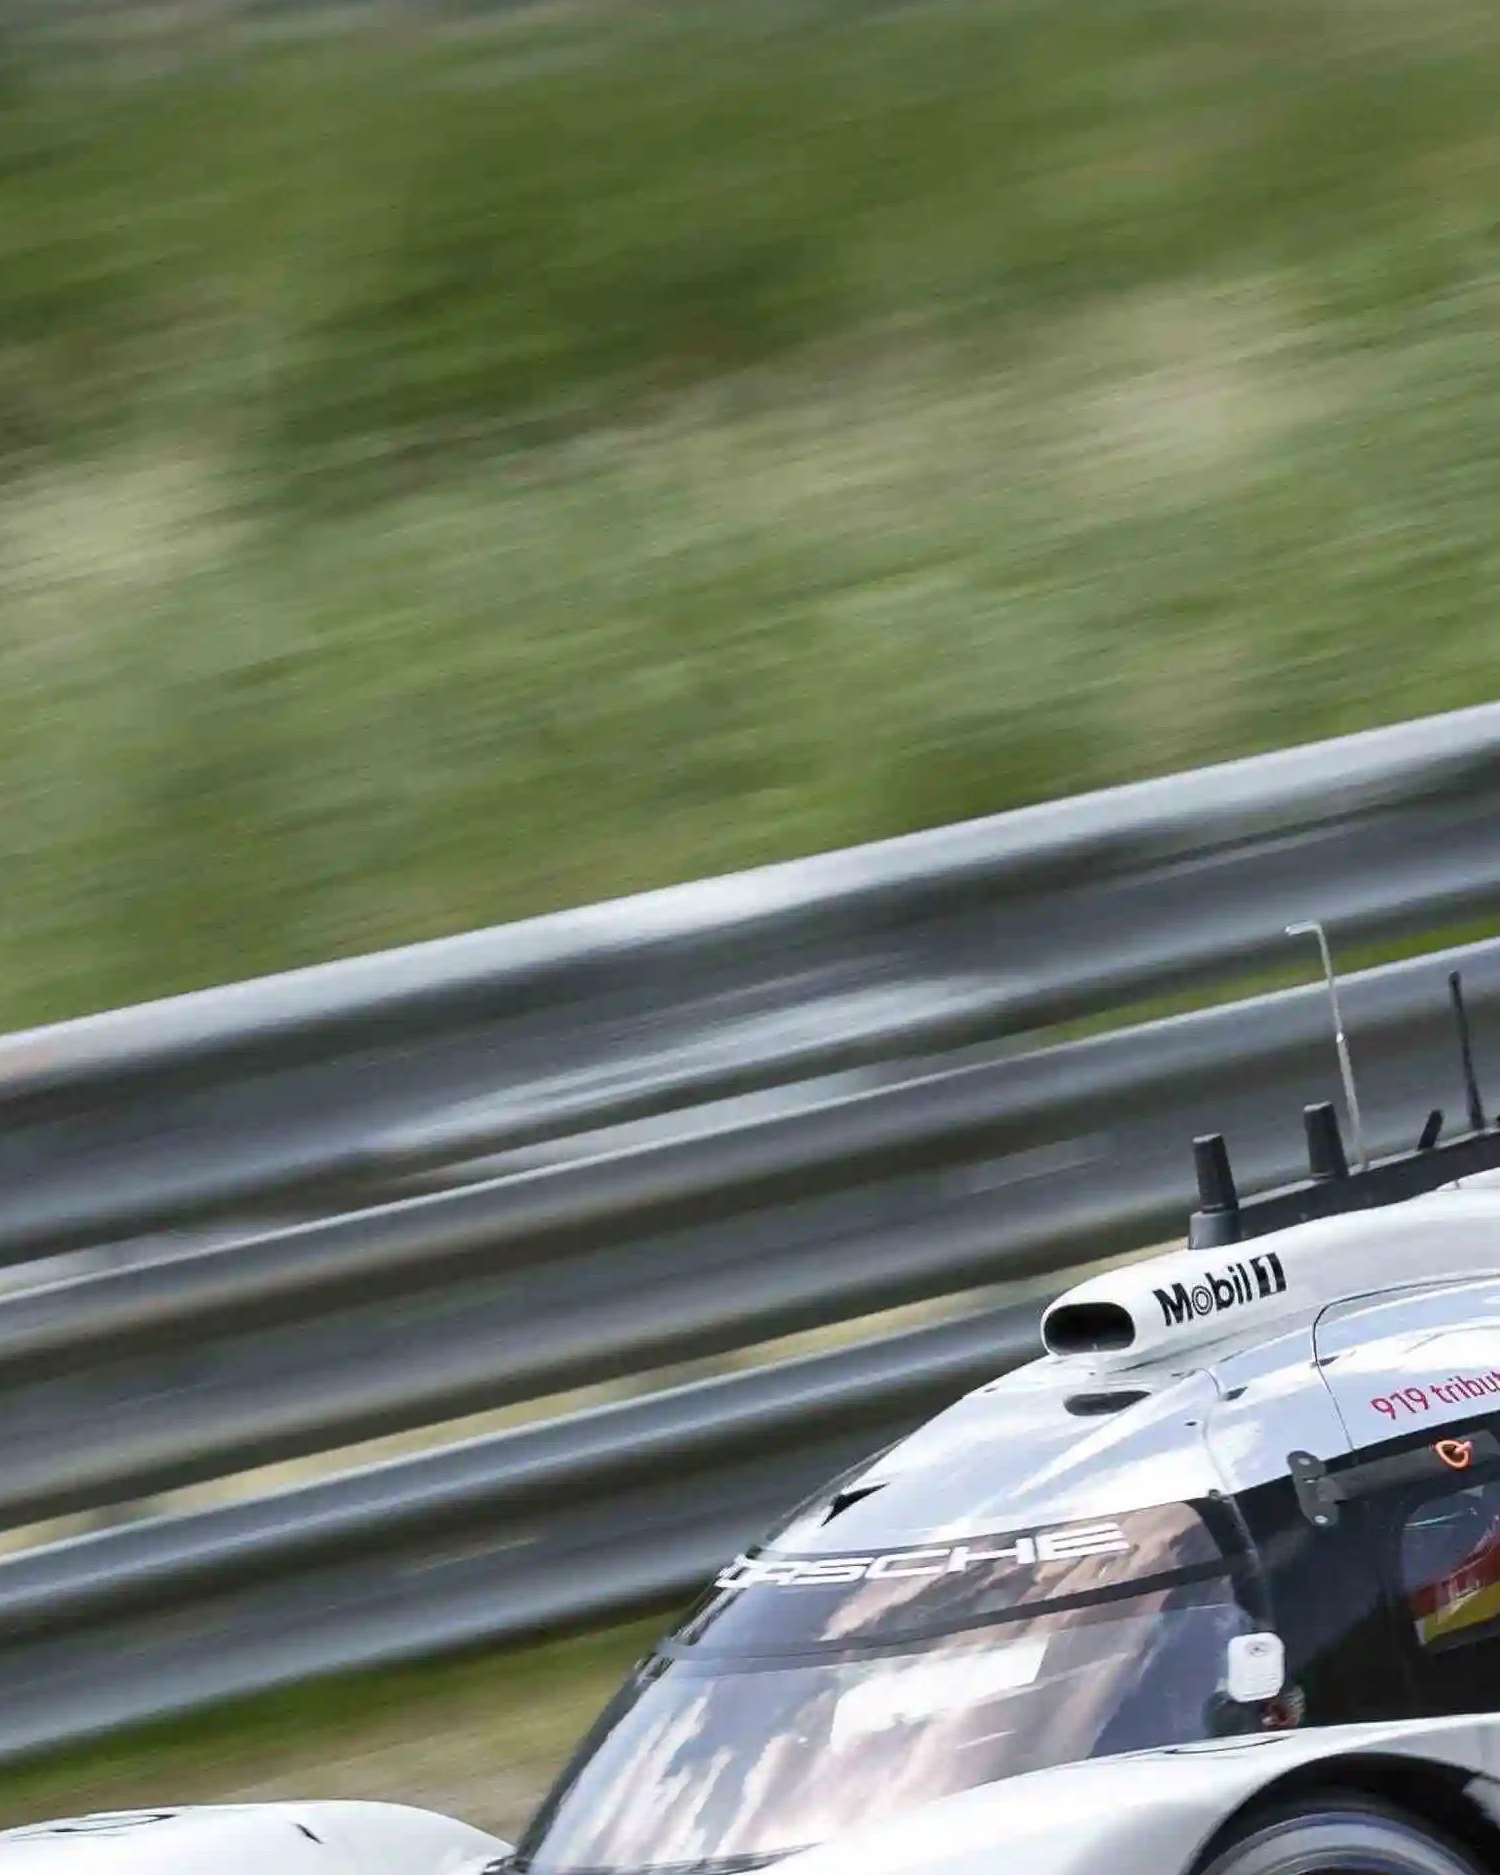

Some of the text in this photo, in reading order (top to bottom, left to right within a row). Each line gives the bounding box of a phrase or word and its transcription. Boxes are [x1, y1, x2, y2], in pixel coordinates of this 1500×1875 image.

[1153, 1252, 1287, 1327] Mobil 1
[1371, 1388, 1429, 1421] 919
